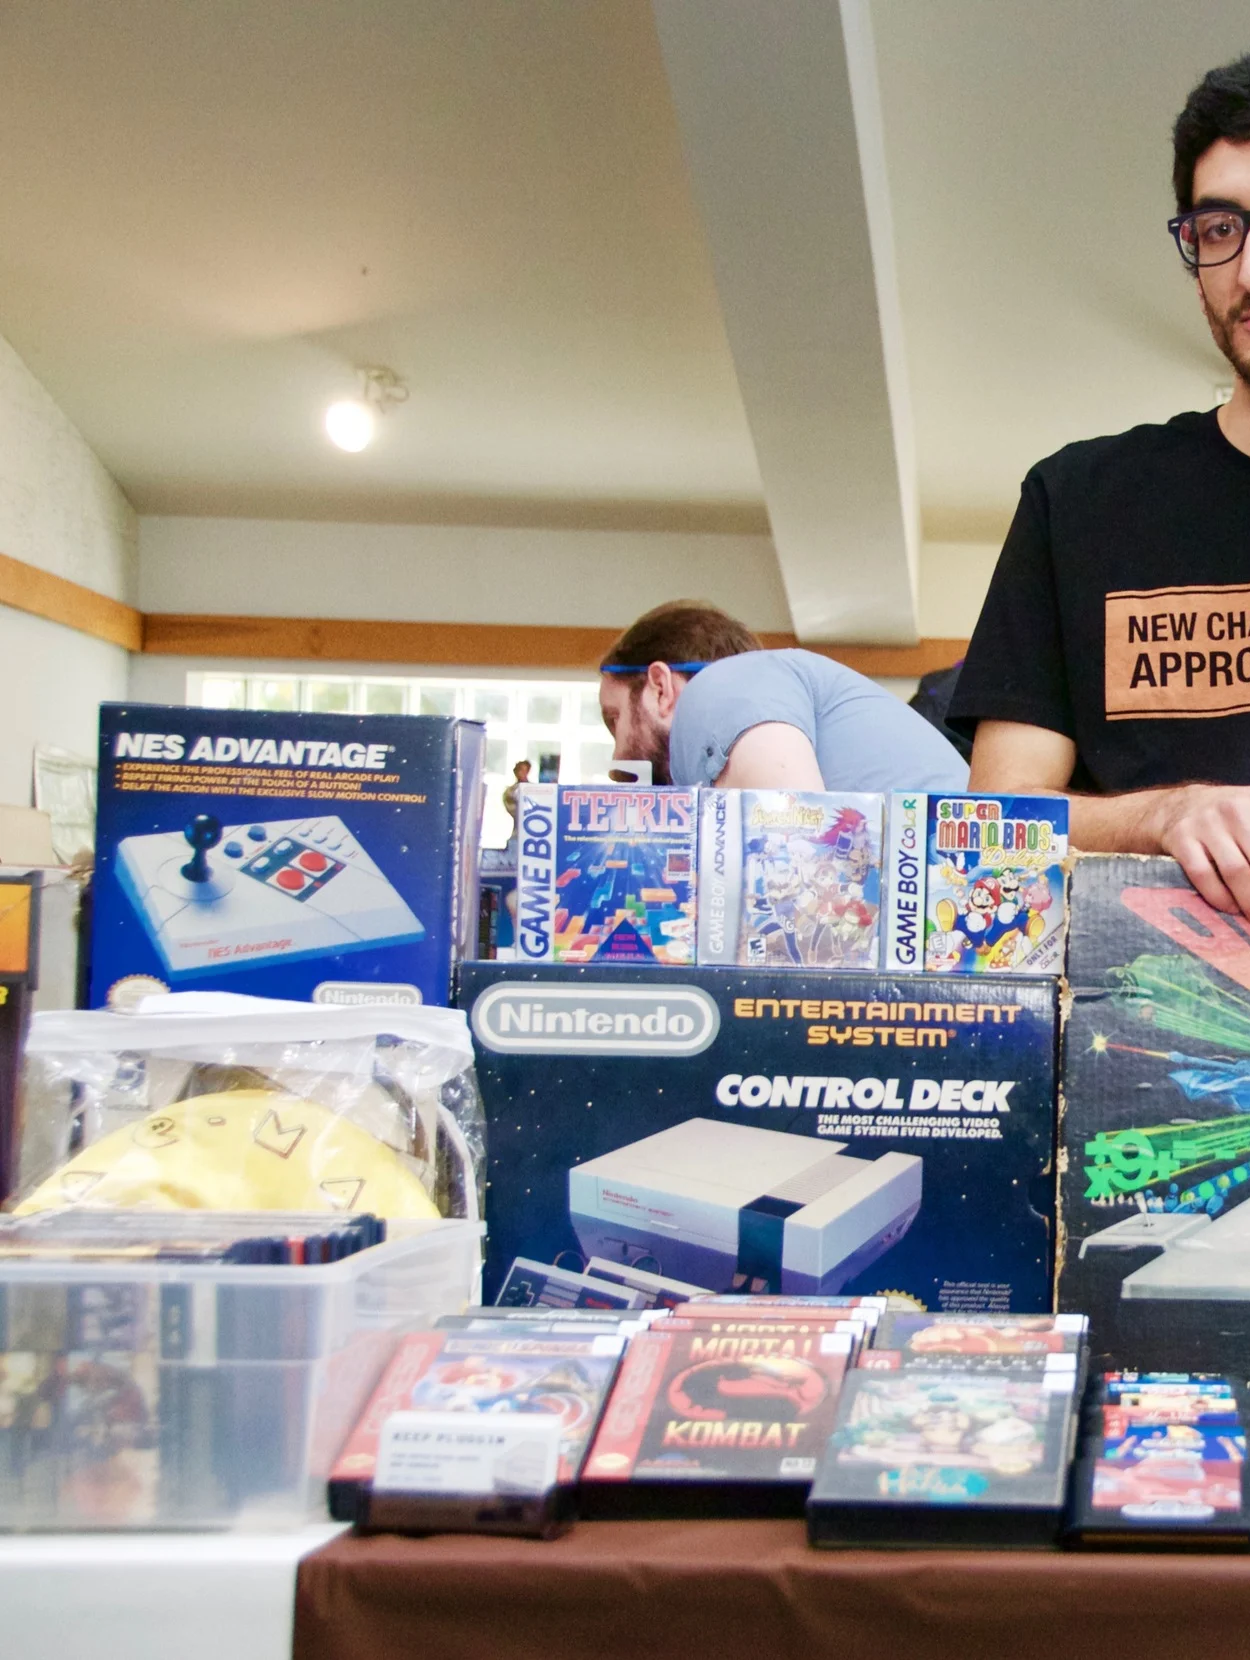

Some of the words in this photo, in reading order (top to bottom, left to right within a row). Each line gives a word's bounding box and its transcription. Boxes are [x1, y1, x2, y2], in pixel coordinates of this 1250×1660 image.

[1127, 612, 1197, 643] NEW
[115, 732, 186, 760] NES
[189, 736, 389, 769] ADVANTAGE
[122, 762, 181, 773] EXPERIENCE
[182, 765, 200, 774] THE
[201, 766, 272, 777] PROFESSIONAL
[273, 769, 294, 778] FEEL
[295, 771, 308, 779] OF
[310, 771, 334, 780] REAL
[335, 772, 373, 782] ARCADE
[374, 774, 400, 783] PLAY!
[122, 773, 157, 782] REPEAT
[158, 774, 192, 783] FIRING
[193, 775, 228, 785] POWER
[229, 776, 241, 785] AT
[243, 777, 260, 786] THE
[262, 778, 294, 788] TOUCH
[295, 780, 310, 788] OF
[310, 780, 318, 789] A
[319, 781, 362, 791] BUTTON!
[121, 782, 151, 791] DELAY
[153, 783, 171, 792] THE
[172, 784, 209, 793] ACTION
[210, 786, 237, 795] WITH
[238, 787, 255, 795] THE
[256, 787, 306, 798] EXCLUSIVE
[308, 790, 335, 799] SLOW
[335, 791, 376, 800] MOTION
[378, 793, 427, 803] CONTROL!
[563, 791, 691, 833] TETRIS
[902, 798, 918, 849] COLOR
[940, 801, 1000, 820] SUPER
[523, 797, 553, 861] BOY
[713, 796, 727, 876] ADVANCE
[938, 820, 999, 849] MARIO
[1003, 822, 1056, 851] BROS.
[898, 850, 919, 895] BOY
[520, 865, 551, 958] GAME
[709, 907, 725, 955] GAME
[896, 901, 918, 965] GAME
[208, 947, 231, 959] NES
[234, 938, 293, 957] Advantage
[325, 988, 411, 1006] Nintendo
[734, 998, 1021, 1024] ENTERTAINMENT
[499, 1002, 695, 1037] Nintendo
[807, 1025, 948, 1047] SYSTEM
[716, 1073, 904, 1111] CONTROL
[908, 1078, 1015, 1112] DECK
[817, 1114, 839, 1124] THE
[840, 1114, 874, 1126] MOST
[876, 1115, 960, 1128] CHALLENGING
[962, 1117, 1000, 1128] VIDEO
[817, 1125, 852, 1136] GAME
[854, 1125, 898, 1137] SYSTEM
[900, 1126, 930, 1138] EVER
[932, 1127, 1003, 1139] DEVELOPED.
[661, 1420, 808, 1448] KOMBAT
